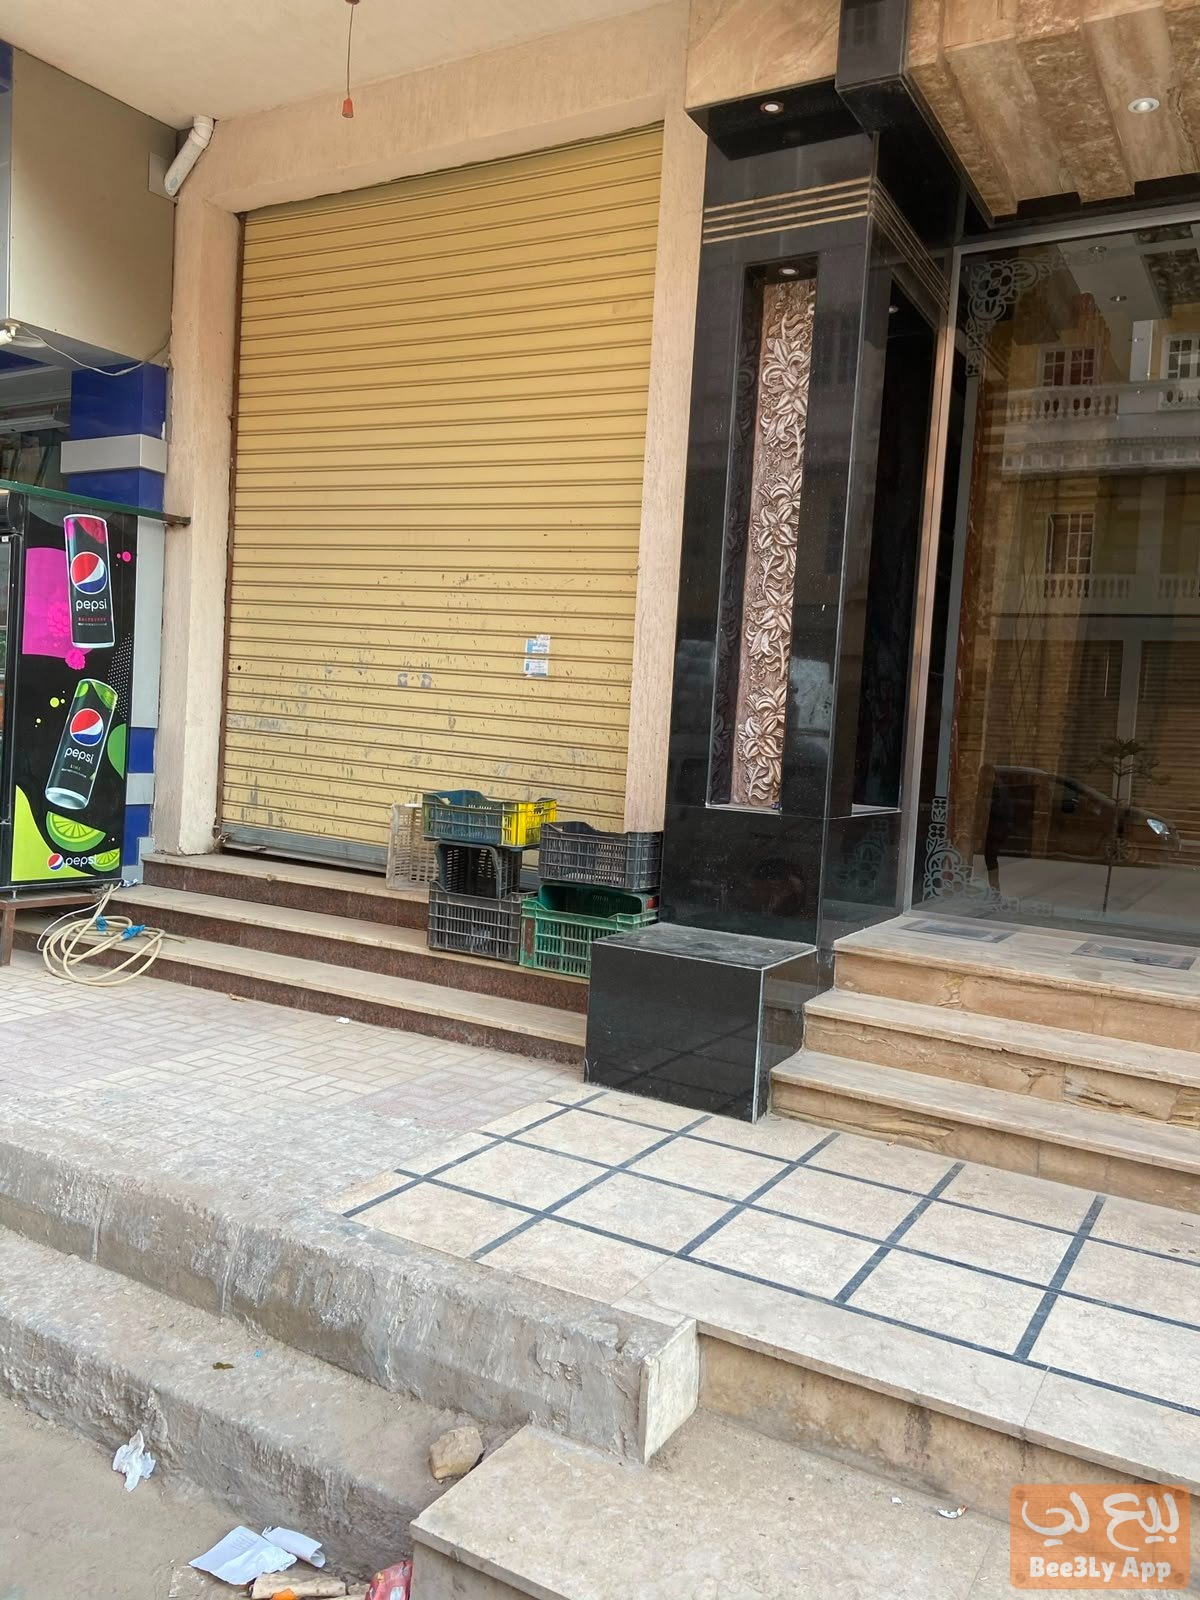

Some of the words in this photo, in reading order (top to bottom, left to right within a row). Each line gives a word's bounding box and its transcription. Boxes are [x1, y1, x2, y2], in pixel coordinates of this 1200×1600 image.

[75, 598, 107, 612] pepsi
[64, 747, 94, 765] pepsi
[65, 854, 97, 868] pepsi
